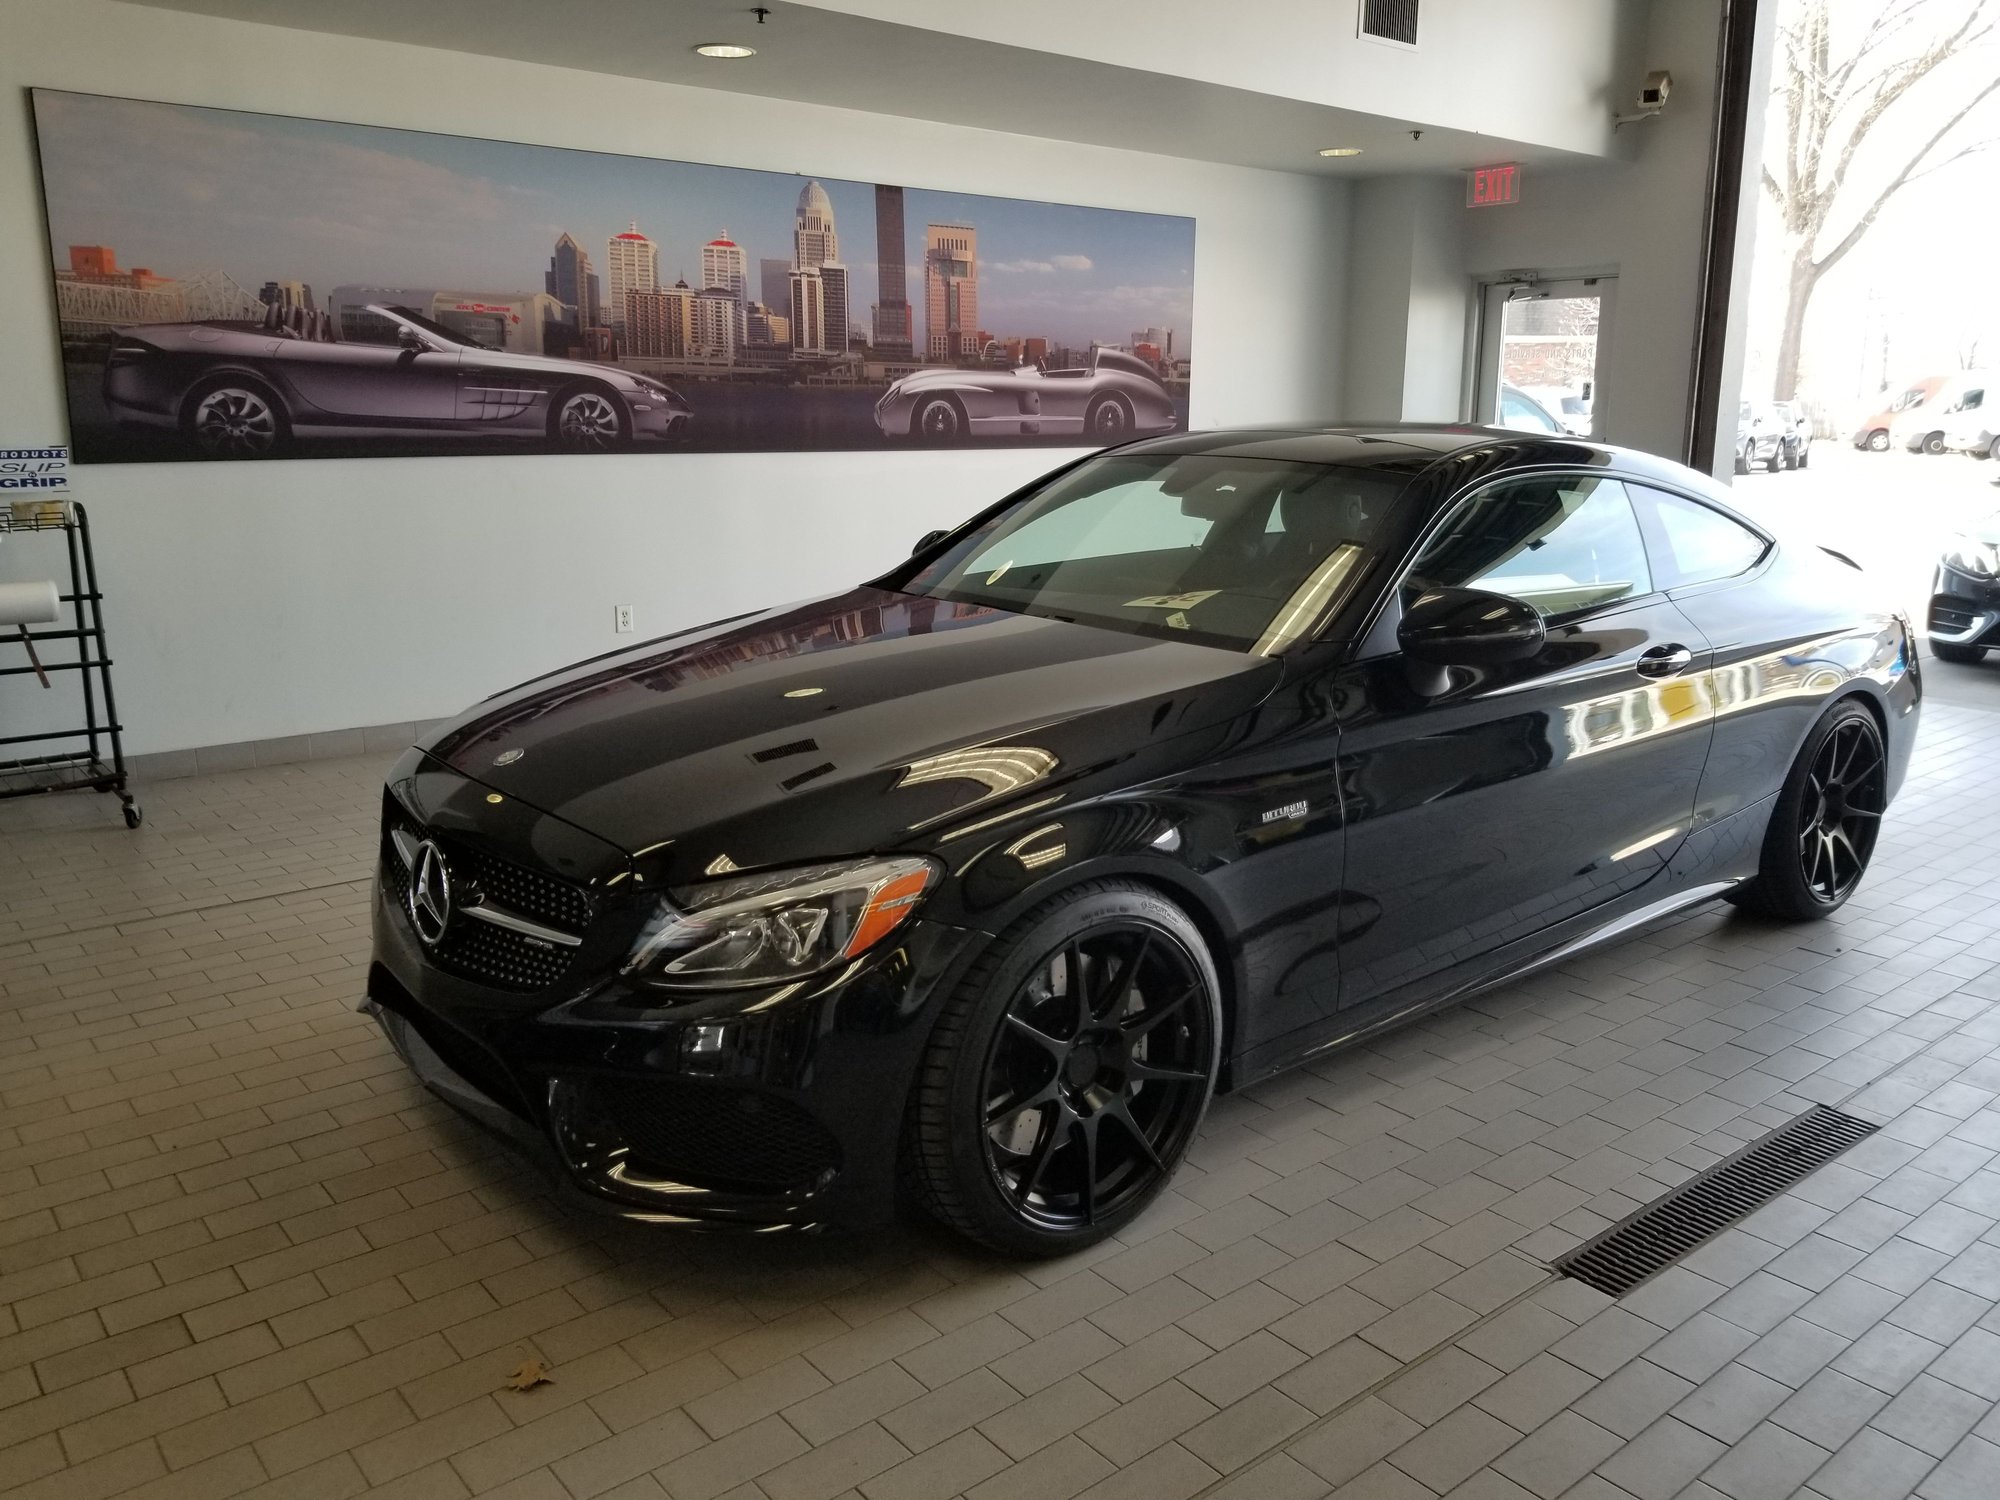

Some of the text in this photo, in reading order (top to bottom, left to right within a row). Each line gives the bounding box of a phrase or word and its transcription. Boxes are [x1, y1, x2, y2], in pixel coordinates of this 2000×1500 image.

[1474, 166, 1514, 203] EXIT
[0, 462, 66, 473] SLIP
[0, 477, 67, 488] GRIP
